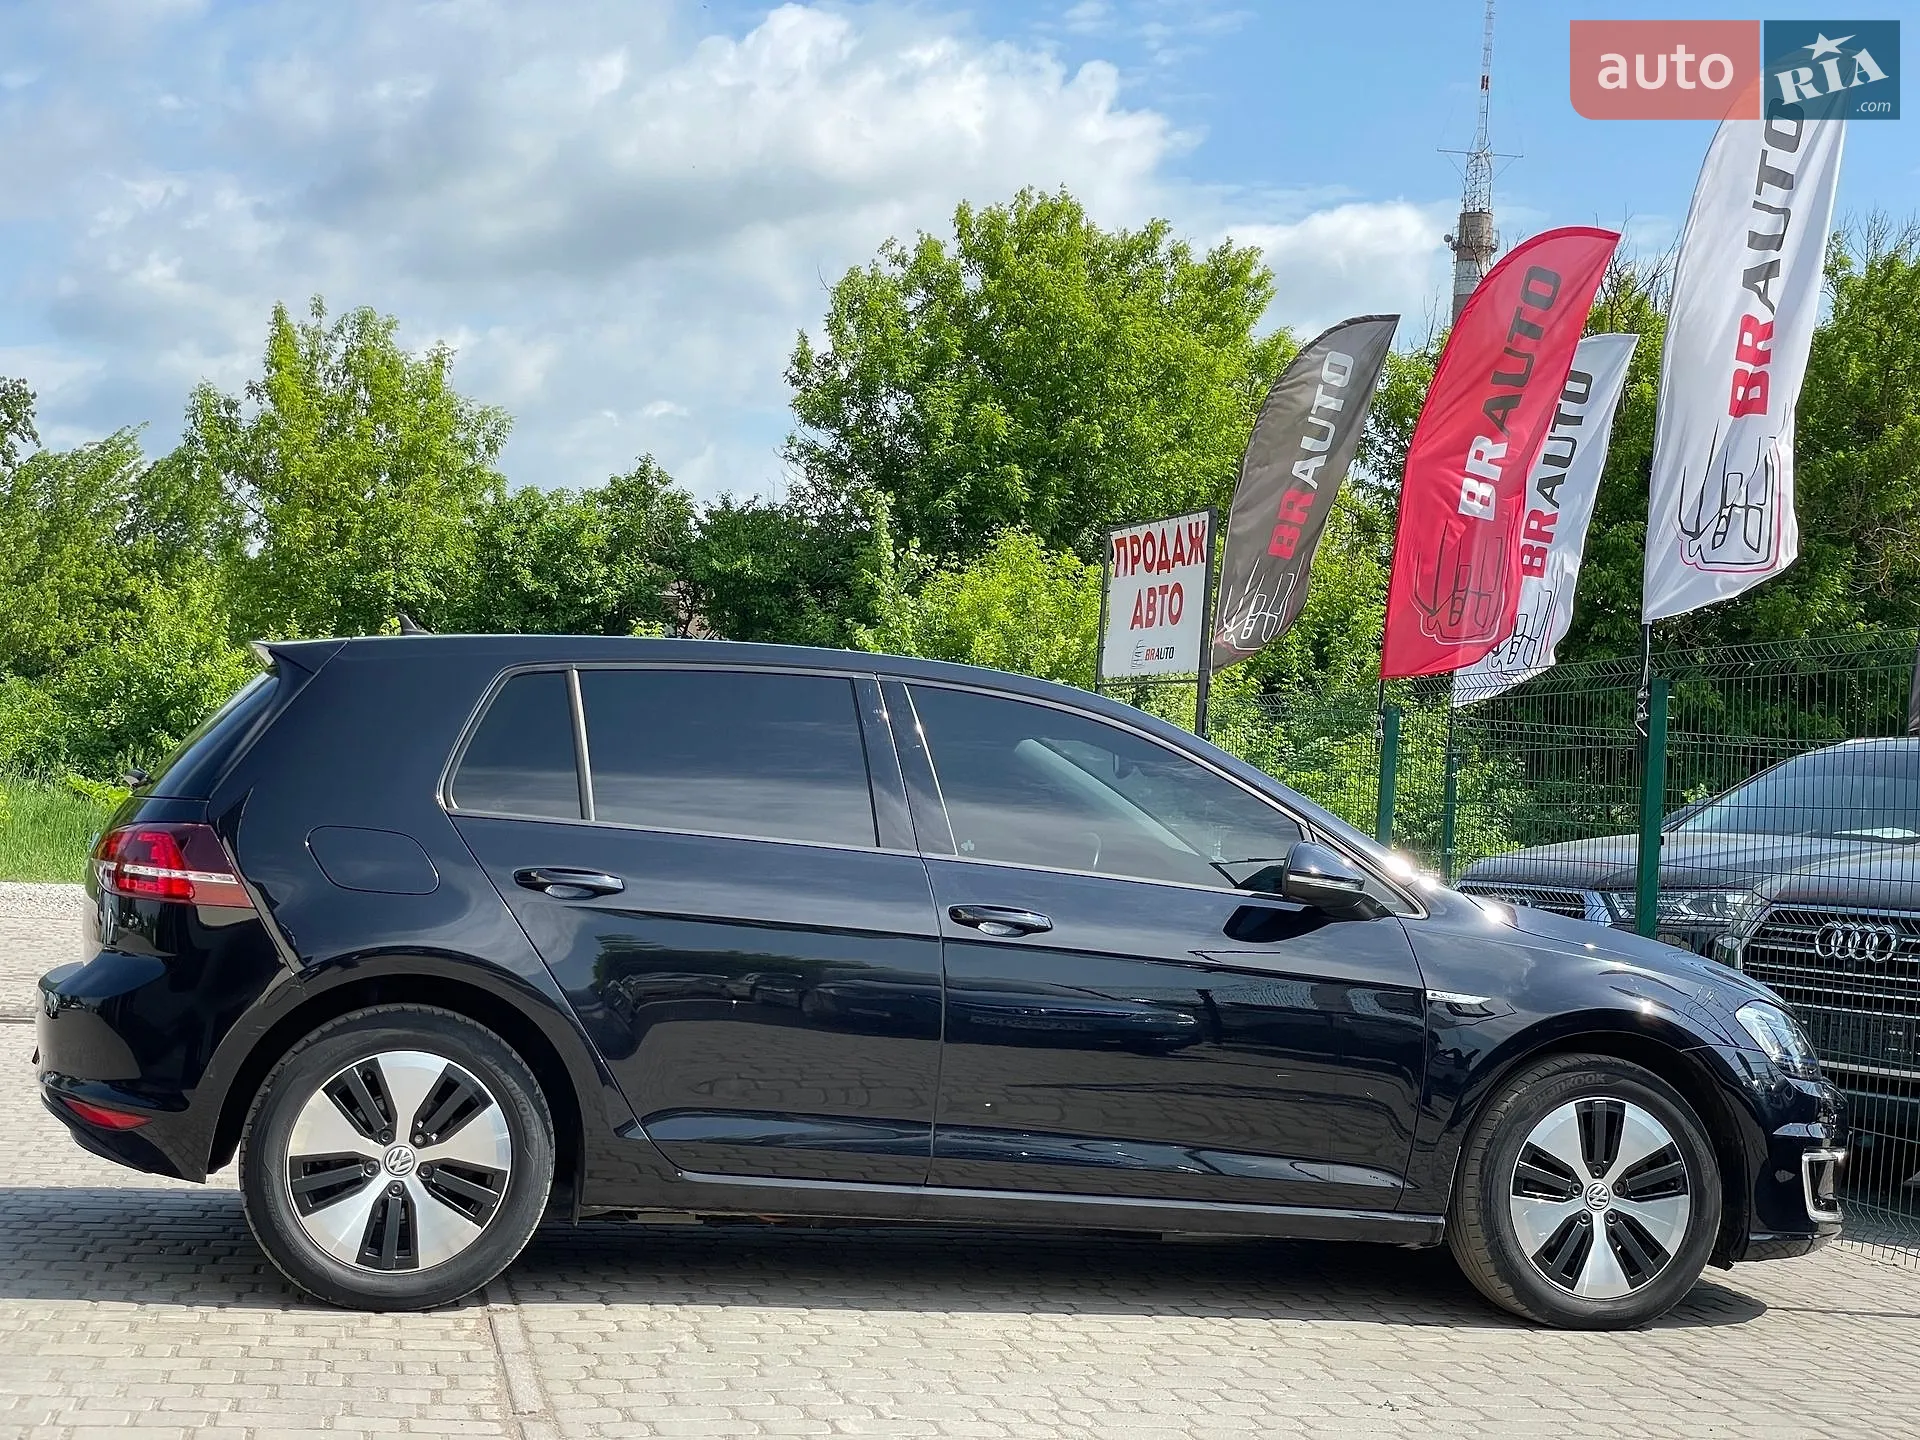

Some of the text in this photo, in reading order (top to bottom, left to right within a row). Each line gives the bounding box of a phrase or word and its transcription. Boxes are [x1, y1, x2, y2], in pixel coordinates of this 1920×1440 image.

[1729, 97, 1805, 419] BRAUTO
[1268, 350, 1354, 560] BRAUTO
[1458, 265, 1562, 521] BRAUTO
[1521, 369, 1593, 579] BRAUTO
[1114, 520, 1206, 578] ПРОДАЖ
[1130, 582, 1184, 630] АВТО
[1145, 646, 1175, 661] BRAUTO
